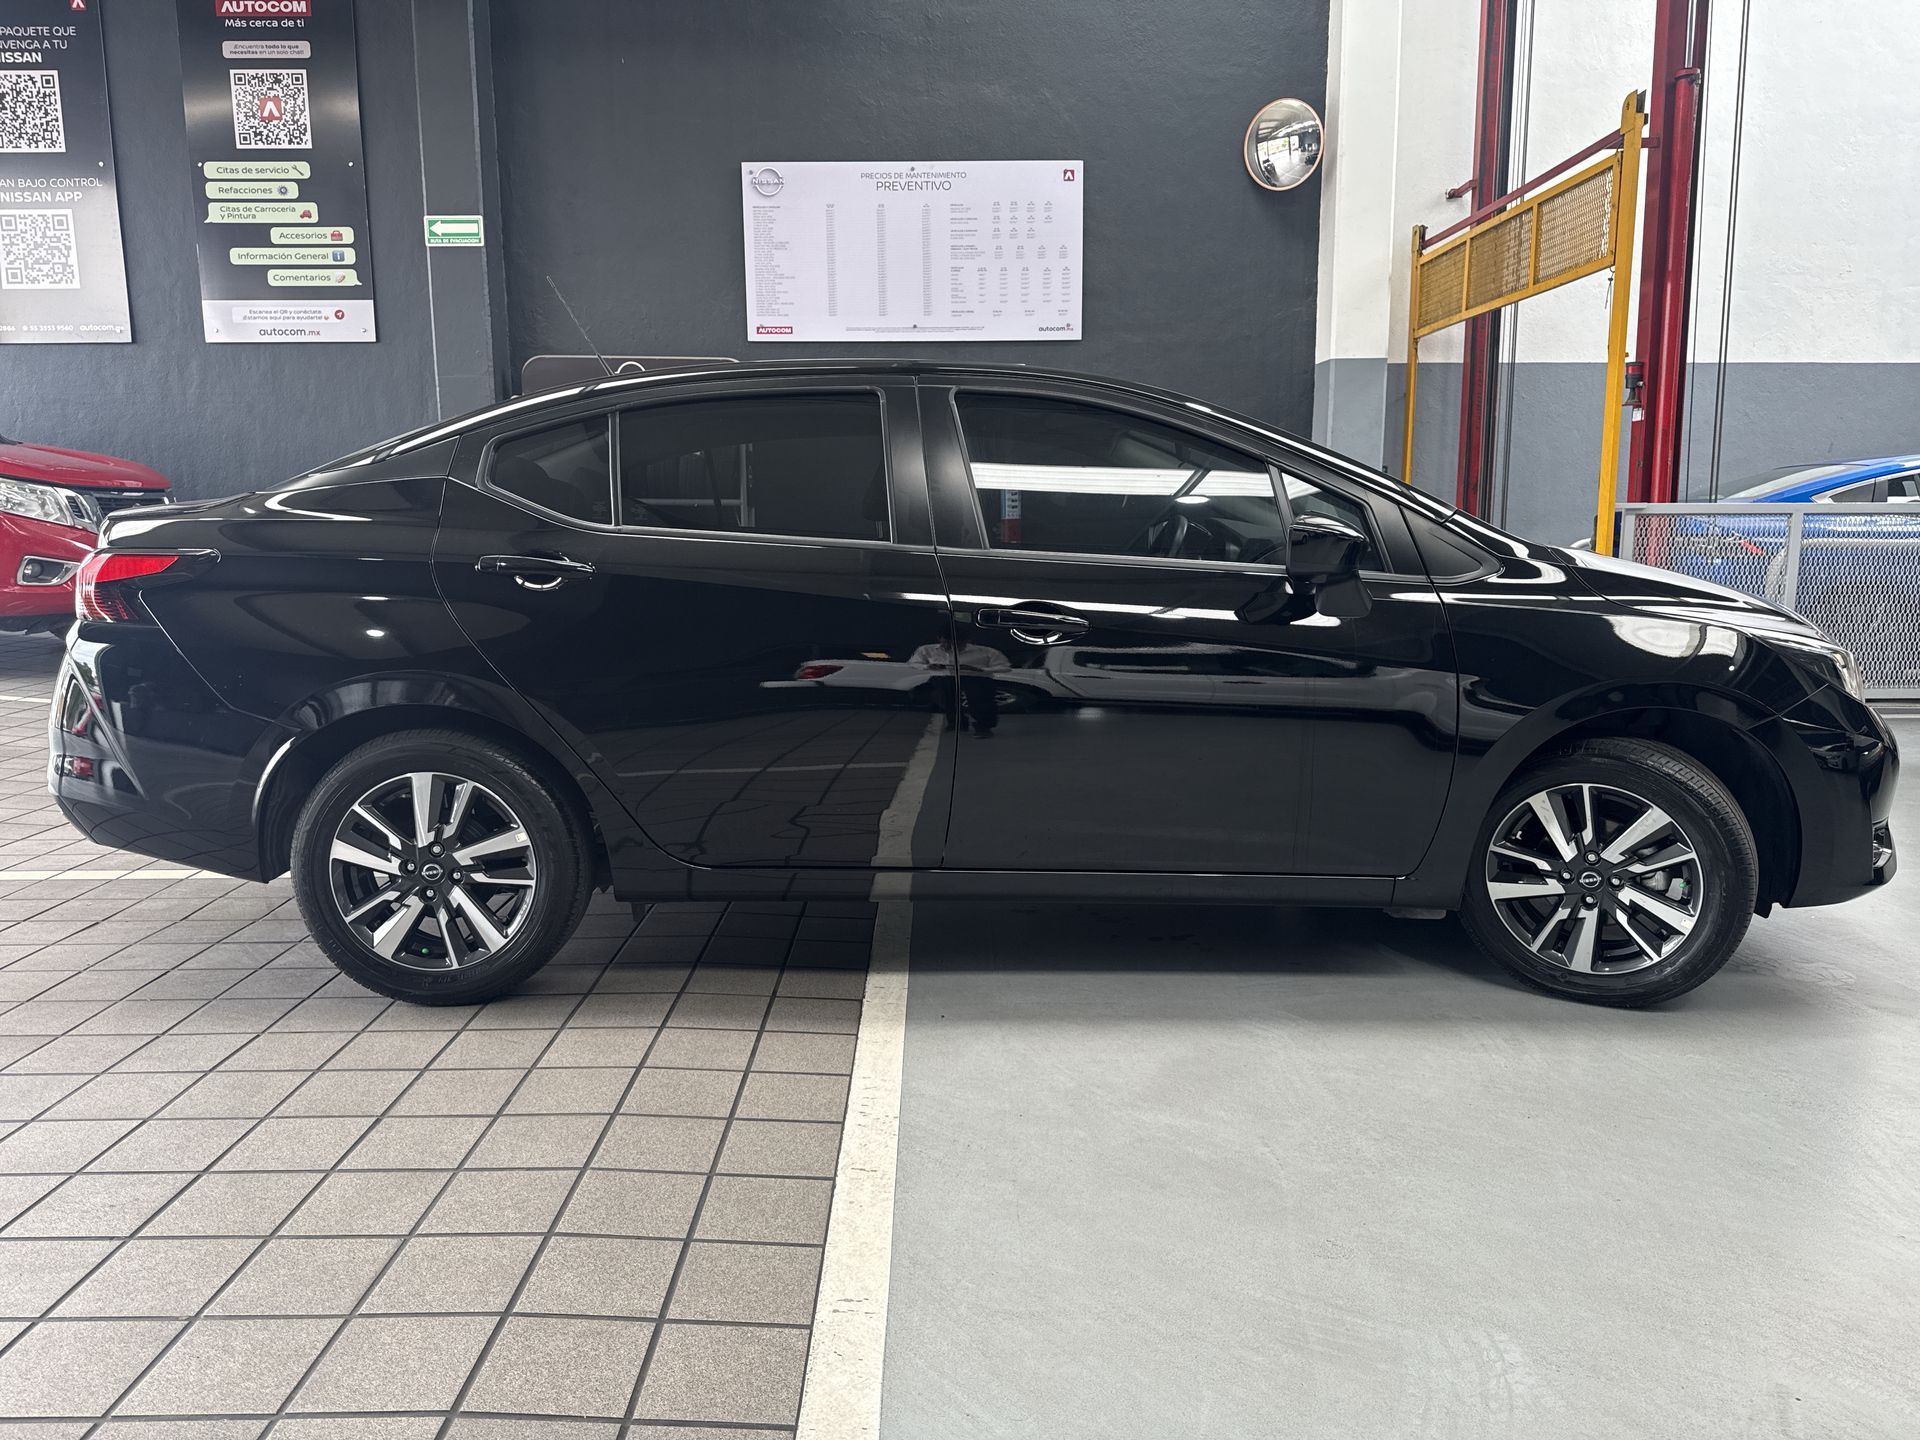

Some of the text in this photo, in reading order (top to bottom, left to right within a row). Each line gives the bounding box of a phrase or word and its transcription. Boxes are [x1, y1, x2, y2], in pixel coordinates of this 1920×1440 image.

[221, 1, 307, 13] AUTOCOM
[224, 18, 305, 28] Más cerca de ti
[0, 26, 77, 36] PAQUETE QUE
[42, 40, 51, 50] A
[52, 40, 68, 49] TU
[0, 52, 42, 63] ISSAN
[216, 166, 290, 174] Citas de servicio
[860, 171, 967, 180] PRECIOS DE MANTENIMIENTO
[18, 178, 47, 188] BAJO
[49, 177, 103, 188] CONTROL
[876, 180, 952, 191] PREVENTIVO
[218, 186, 273, 194] Refacciones
[0, 191, 83, 203] NISSAN APP
[219, 205, 241, 213] Citas
[242, 205, 253, 213] de
[219, 212, 257, 221] y Pintura
[278, 231, 328, 240] Accesorios
[237, 252, 329, 260] Información General
[272, 274, 332, 282] Comentarios
[259, 327, 321, 336] autocom.mx
